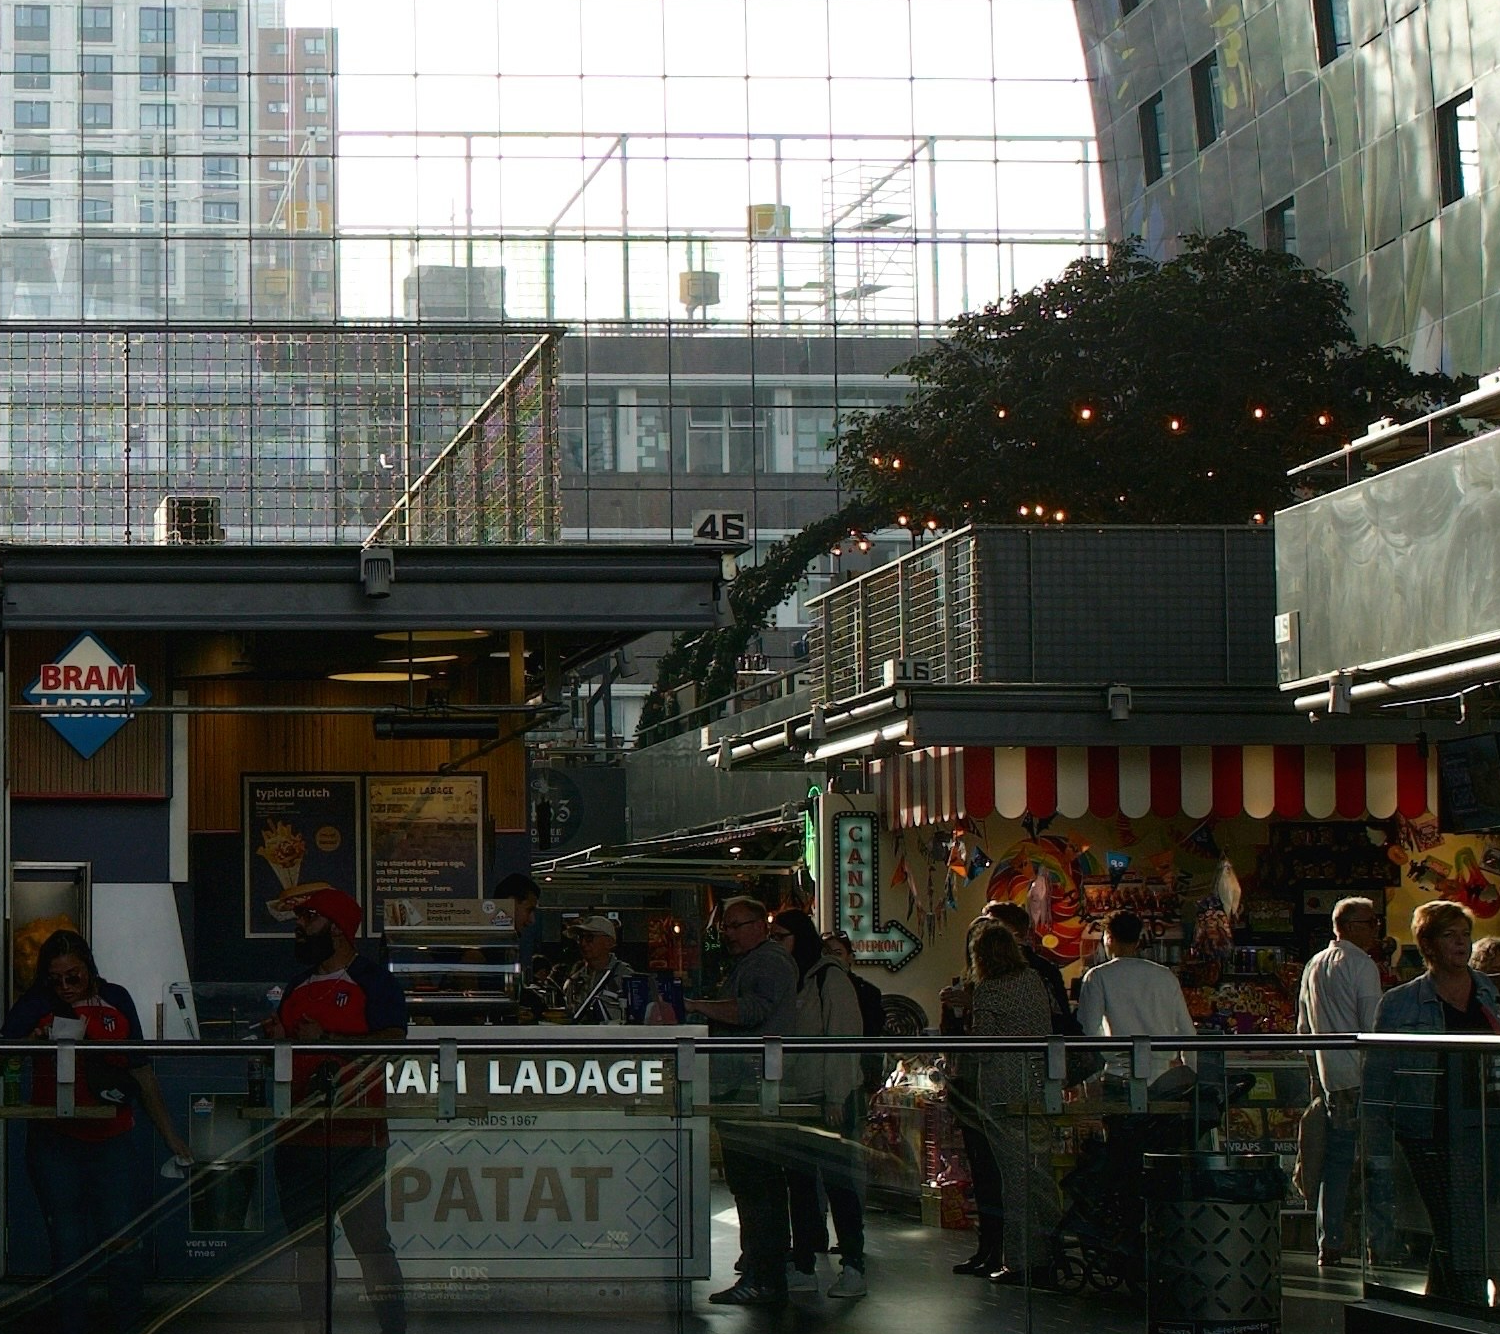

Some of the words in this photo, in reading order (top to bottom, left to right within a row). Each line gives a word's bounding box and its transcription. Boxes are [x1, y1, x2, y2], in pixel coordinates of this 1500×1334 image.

[697, 513, 744, 539] 46
[41, 664, 136, 692] BRAM
[896, 661, 930, 681] 16
[255, 787, 295, 801] typical
[296, 787, 331, 799] dutch
[847, 825, 865, 932] CANDY
[488, 1059, 664, 1096] LADAGE
[468, 1115, 508, 1126] SINDS
[510, 1115, 538, 1126] 1967
[390, 1167, 614, 1222] PATAT
[185, 1240, 208, 1248] vers
[208, 1240, 227, 1248] van
